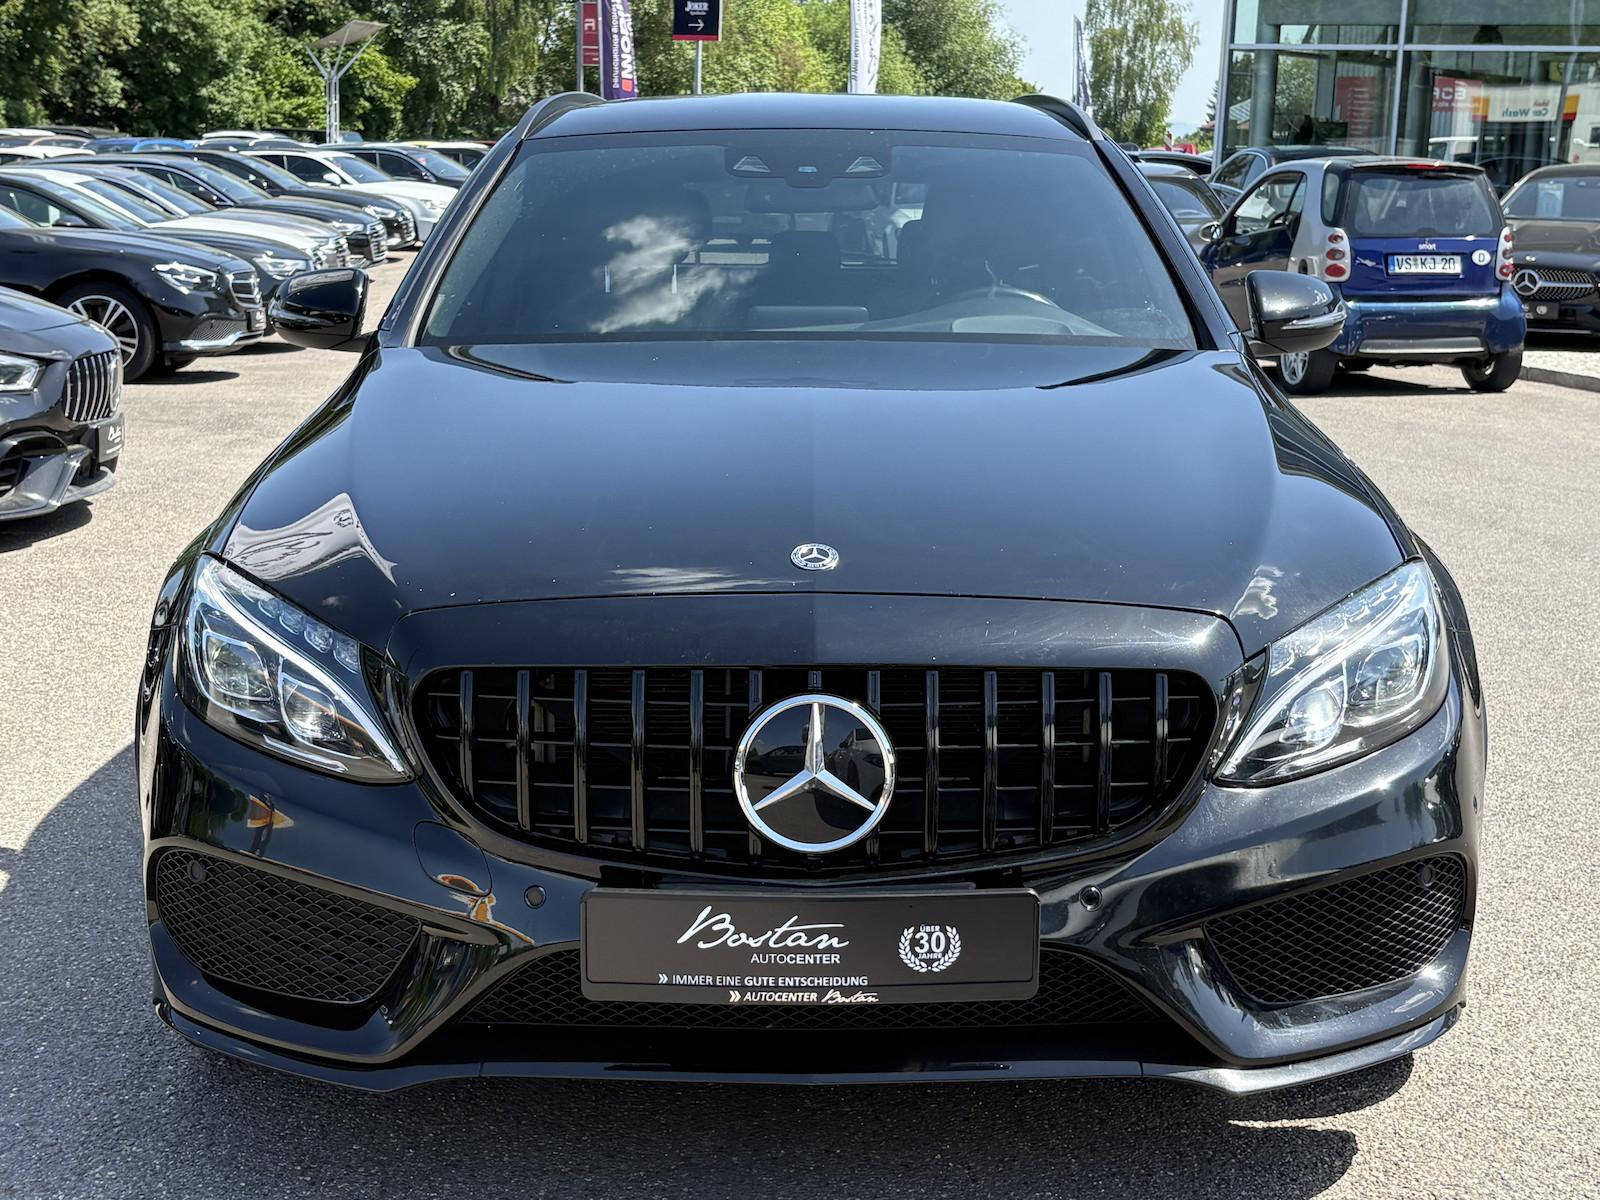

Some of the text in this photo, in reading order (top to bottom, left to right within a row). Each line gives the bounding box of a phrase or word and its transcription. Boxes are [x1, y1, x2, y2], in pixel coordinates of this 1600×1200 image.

[1418, 243, 1437, 251] smart
[1396, 256, 1412, 271] VS
[677, 905, 850, 949] Bostan
[919, 924, 941, 933] ÜBER
[914, 931, 946, 954] 30
[750, 953, 841, 964] AUTOCENTER
[672, 974, 868, 987] IMMER EINE GUTE ENTSCHEIDUNG
[743, 988, 879, 1004] AUTOCENTER Bostan
